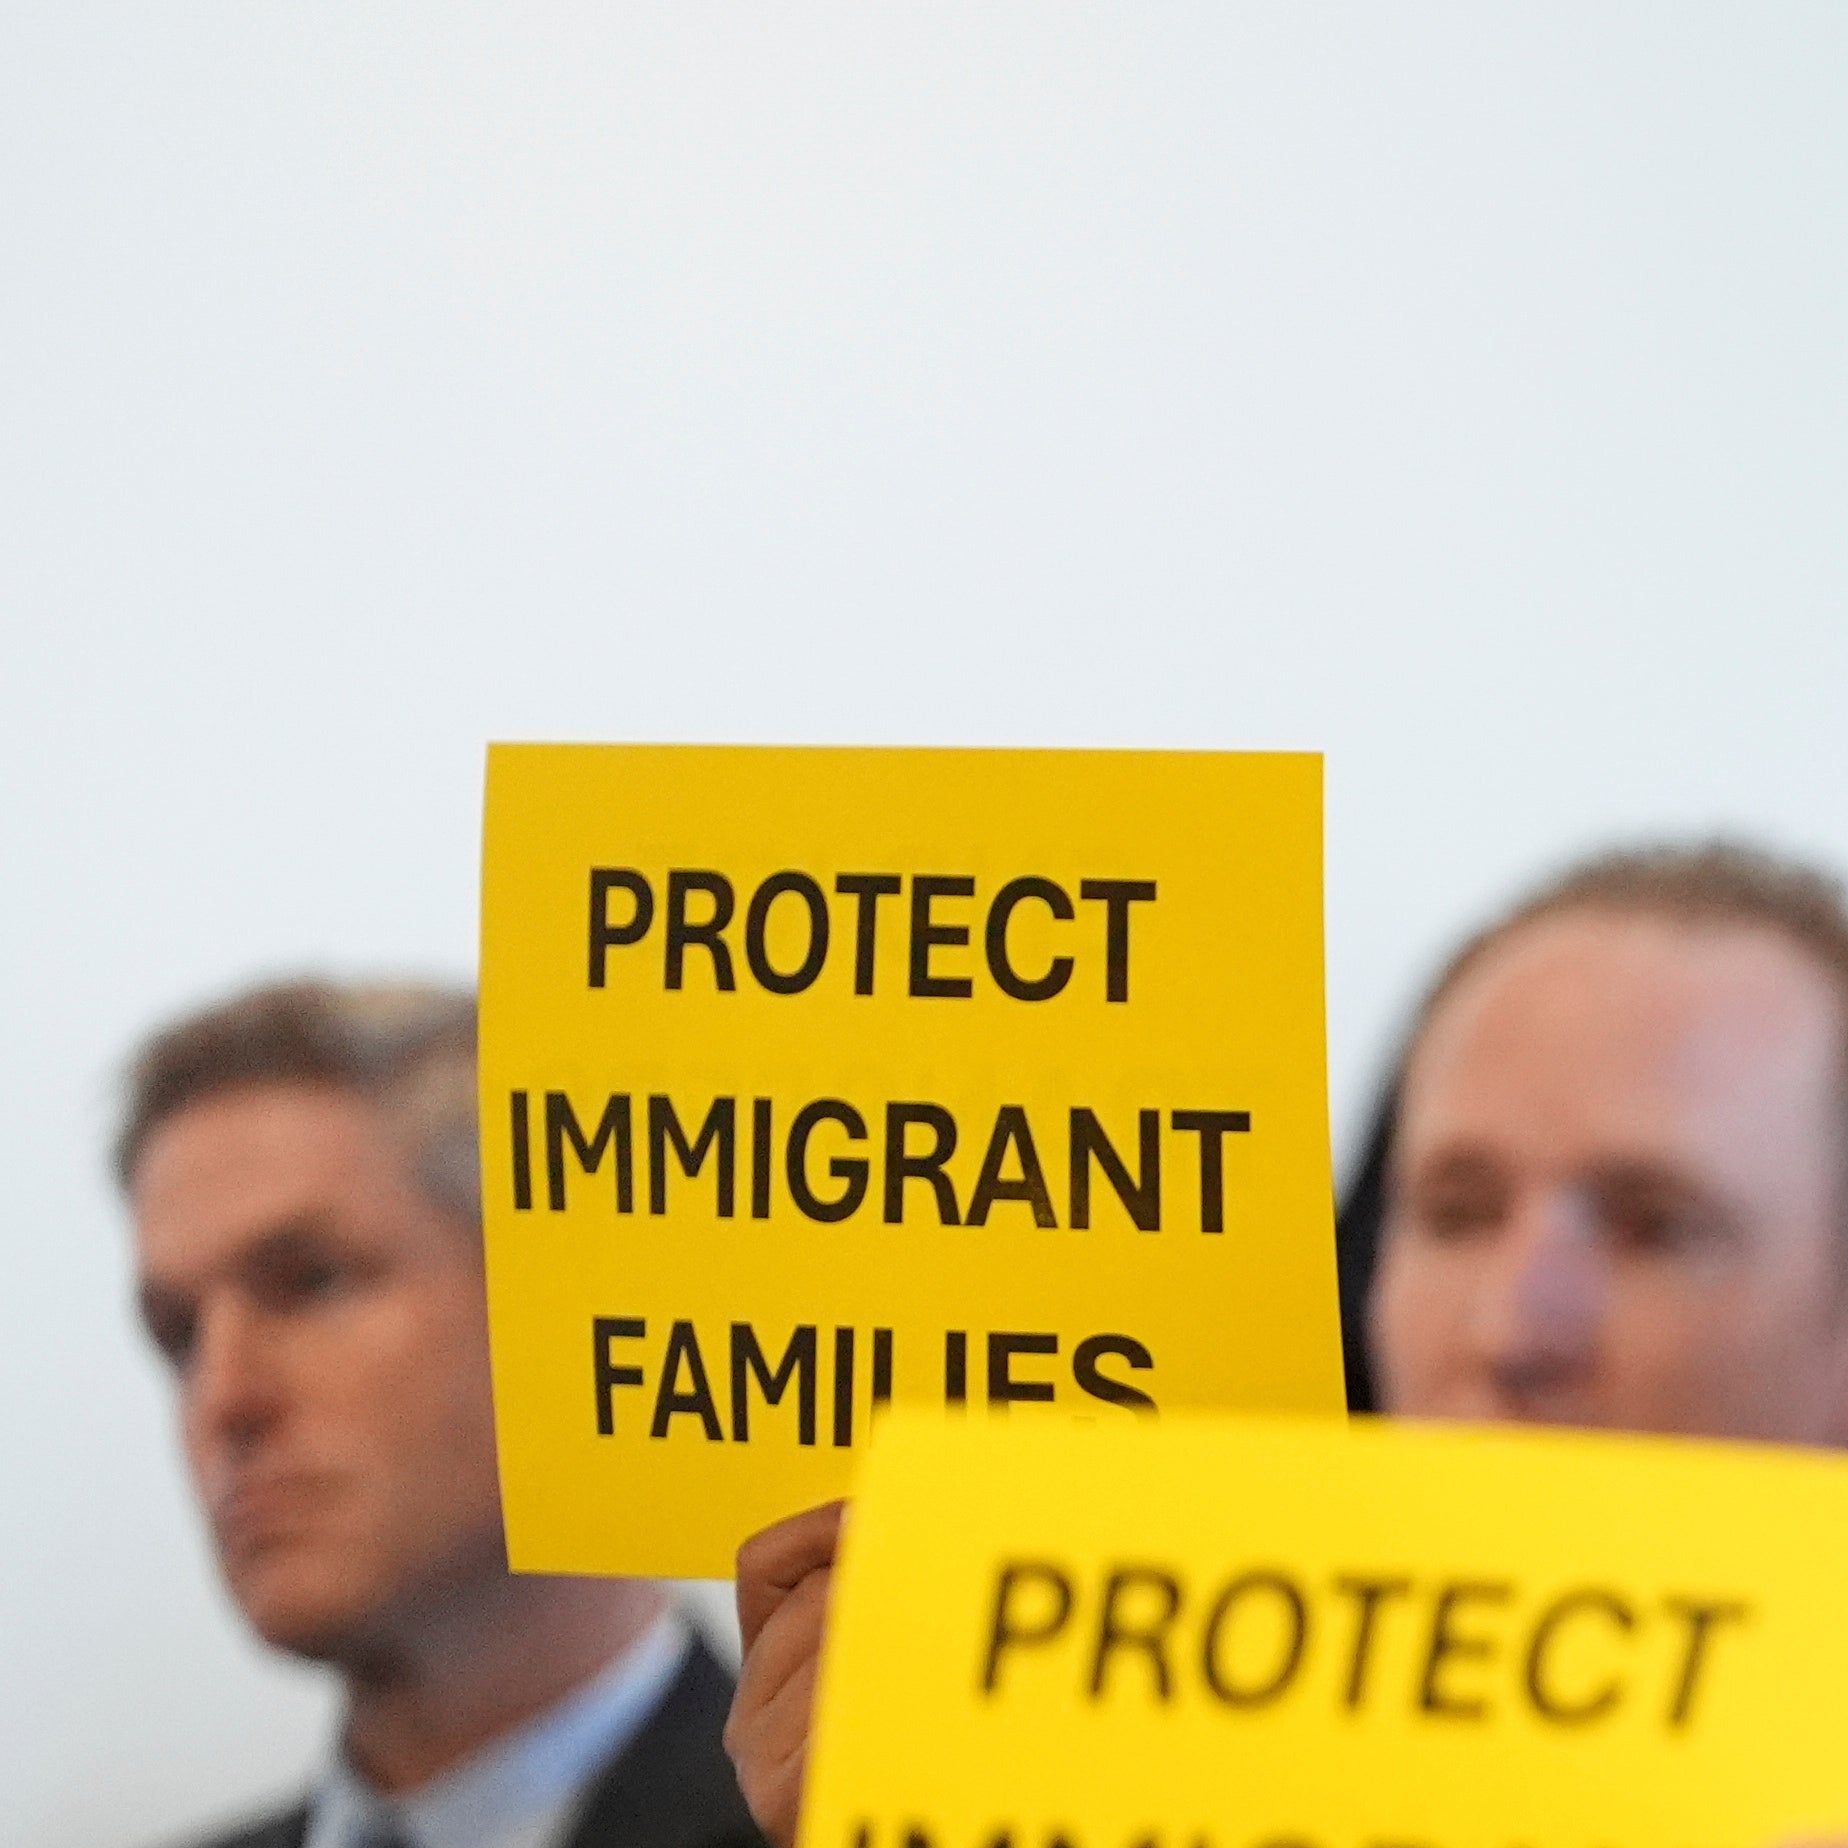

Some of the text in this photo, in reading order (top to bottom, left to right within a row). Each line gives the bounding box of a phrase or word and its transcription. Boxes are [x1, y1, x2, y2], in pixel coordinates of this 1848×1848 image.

[587, 867, 1158, 1004] PROTECT
[509, 1089, 1252, 1234] IMMIGRANT
[976, 1560, 1746, 1728] PROTECT
